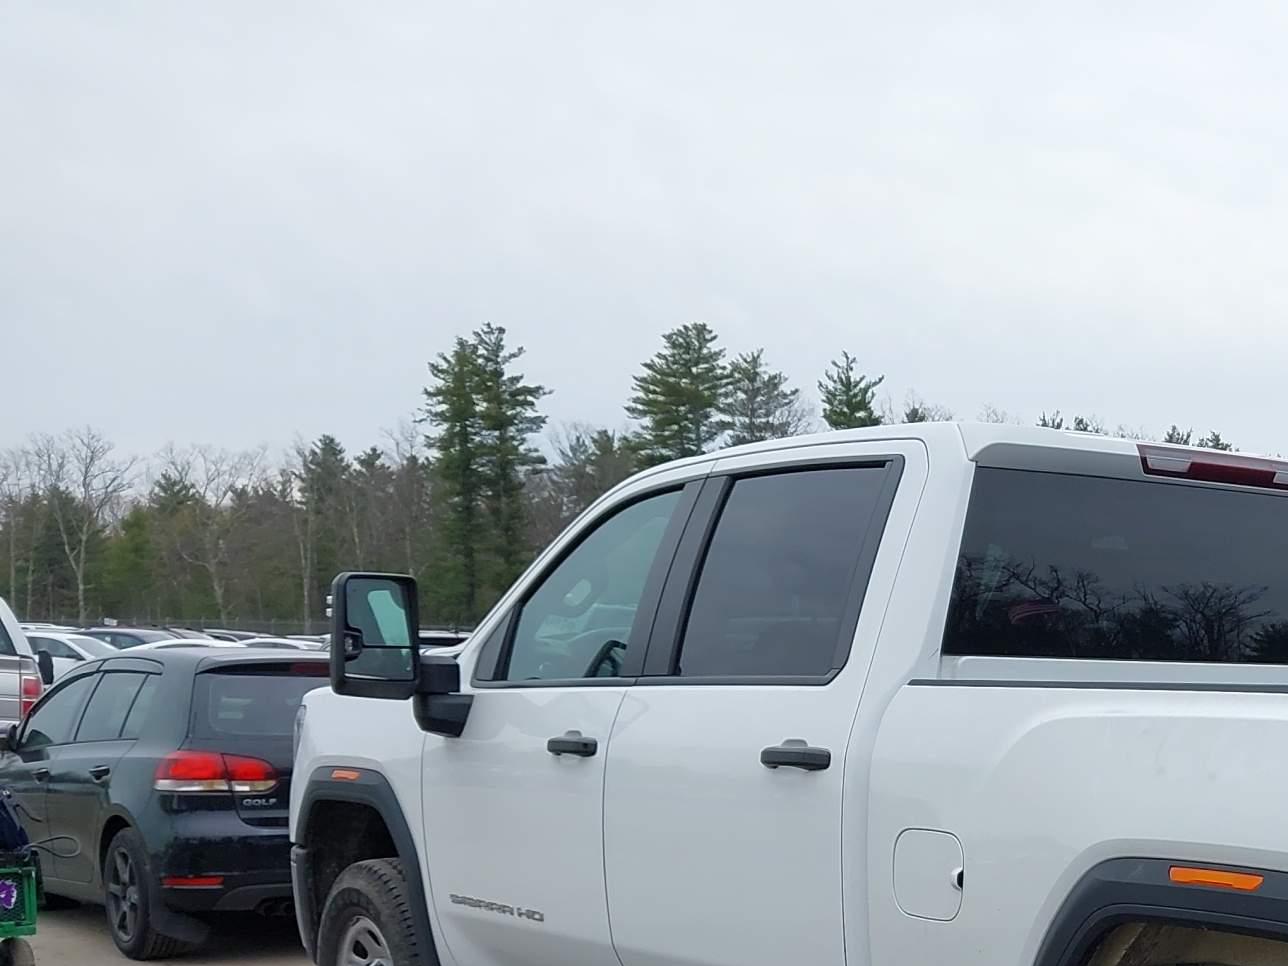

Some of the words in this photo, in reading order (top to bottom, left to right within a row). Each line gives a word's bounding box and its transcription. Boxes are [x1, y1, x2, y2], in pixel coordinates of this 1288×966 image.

[242, 798, 277, 806] GOLF
[450, 895, 514, 915] SIERRA
[517, 908, 544, 922] HD
